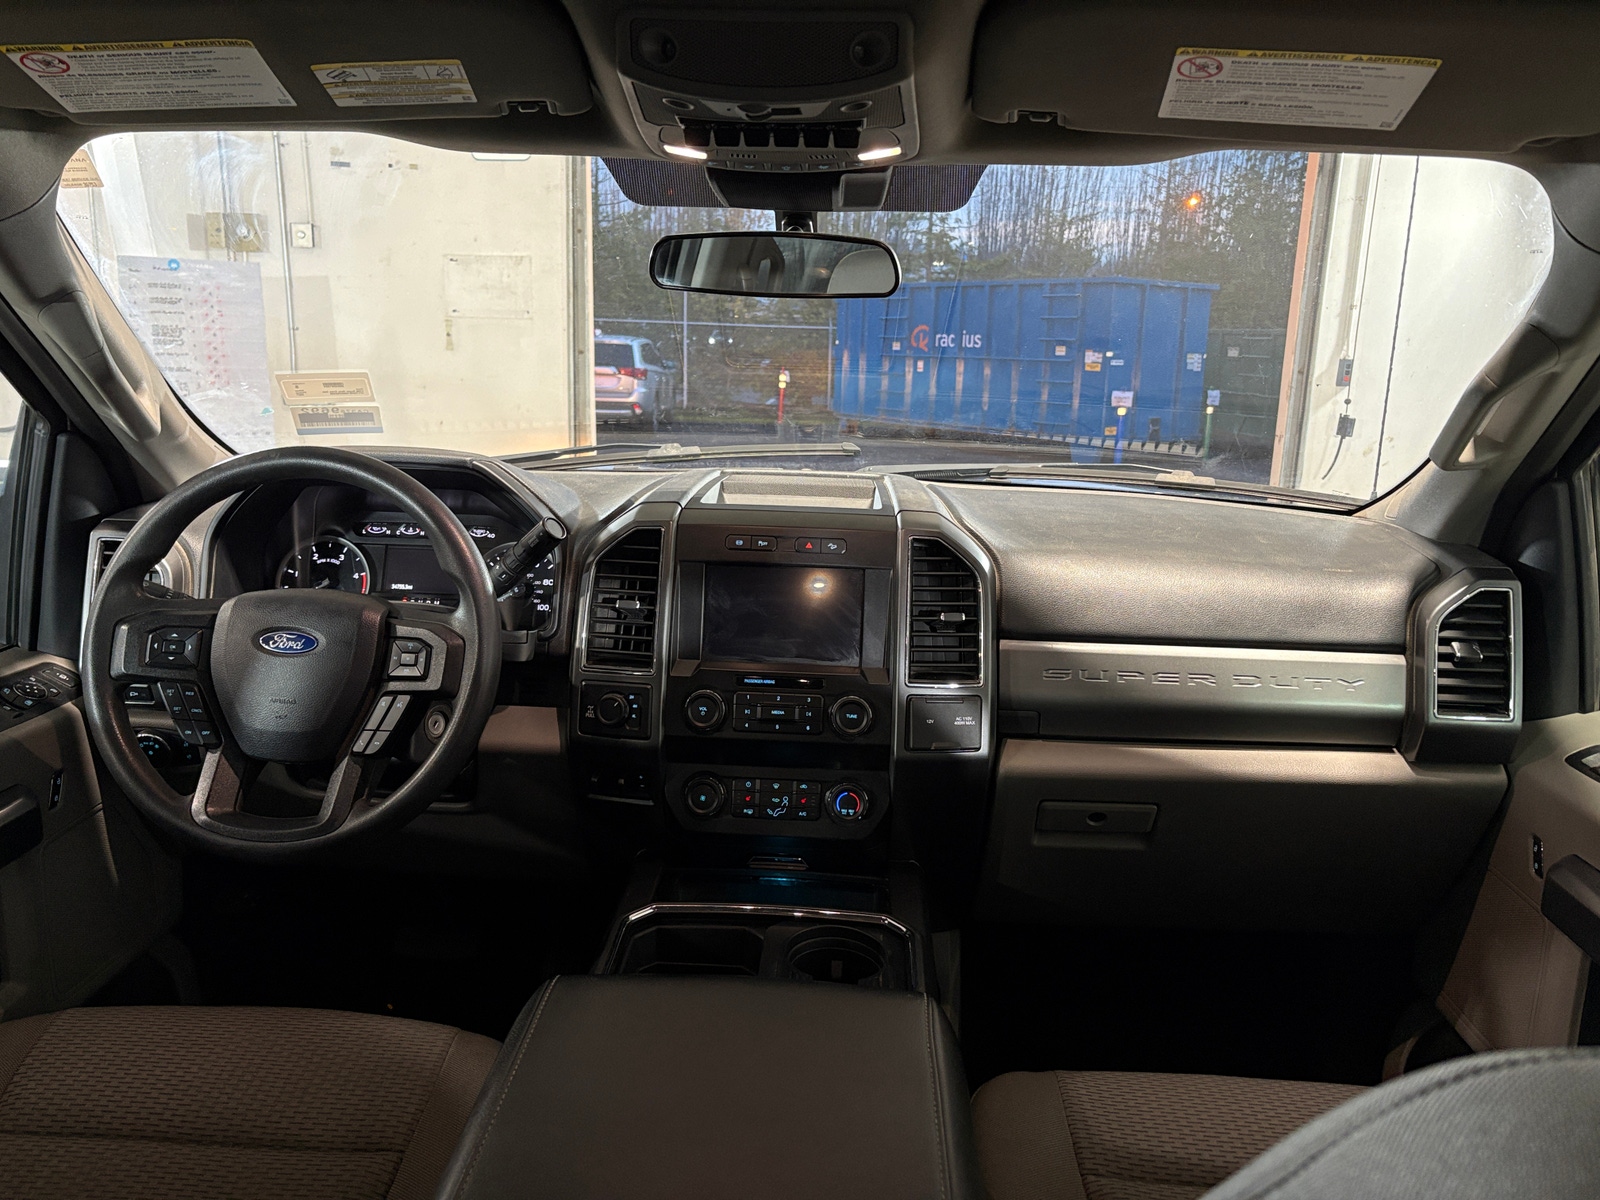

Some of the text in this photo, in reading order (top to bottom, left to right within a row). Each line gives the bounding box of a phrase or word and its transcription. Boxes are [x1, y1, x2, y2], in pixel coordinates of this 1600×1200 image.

[84, 42, 165, 51] AVERTISSEMENT
[1260, 52, 1345, 60] AVERTISSEMENT
[1367, 57, 1438, 66] ADVERTENCIA
[352, 572, 359, 580] 4
[542, 578, 554, 586] 80
[269, 633, 305, 650] Ford
[1043, 668, 1365, 692] SUPER DUTY
